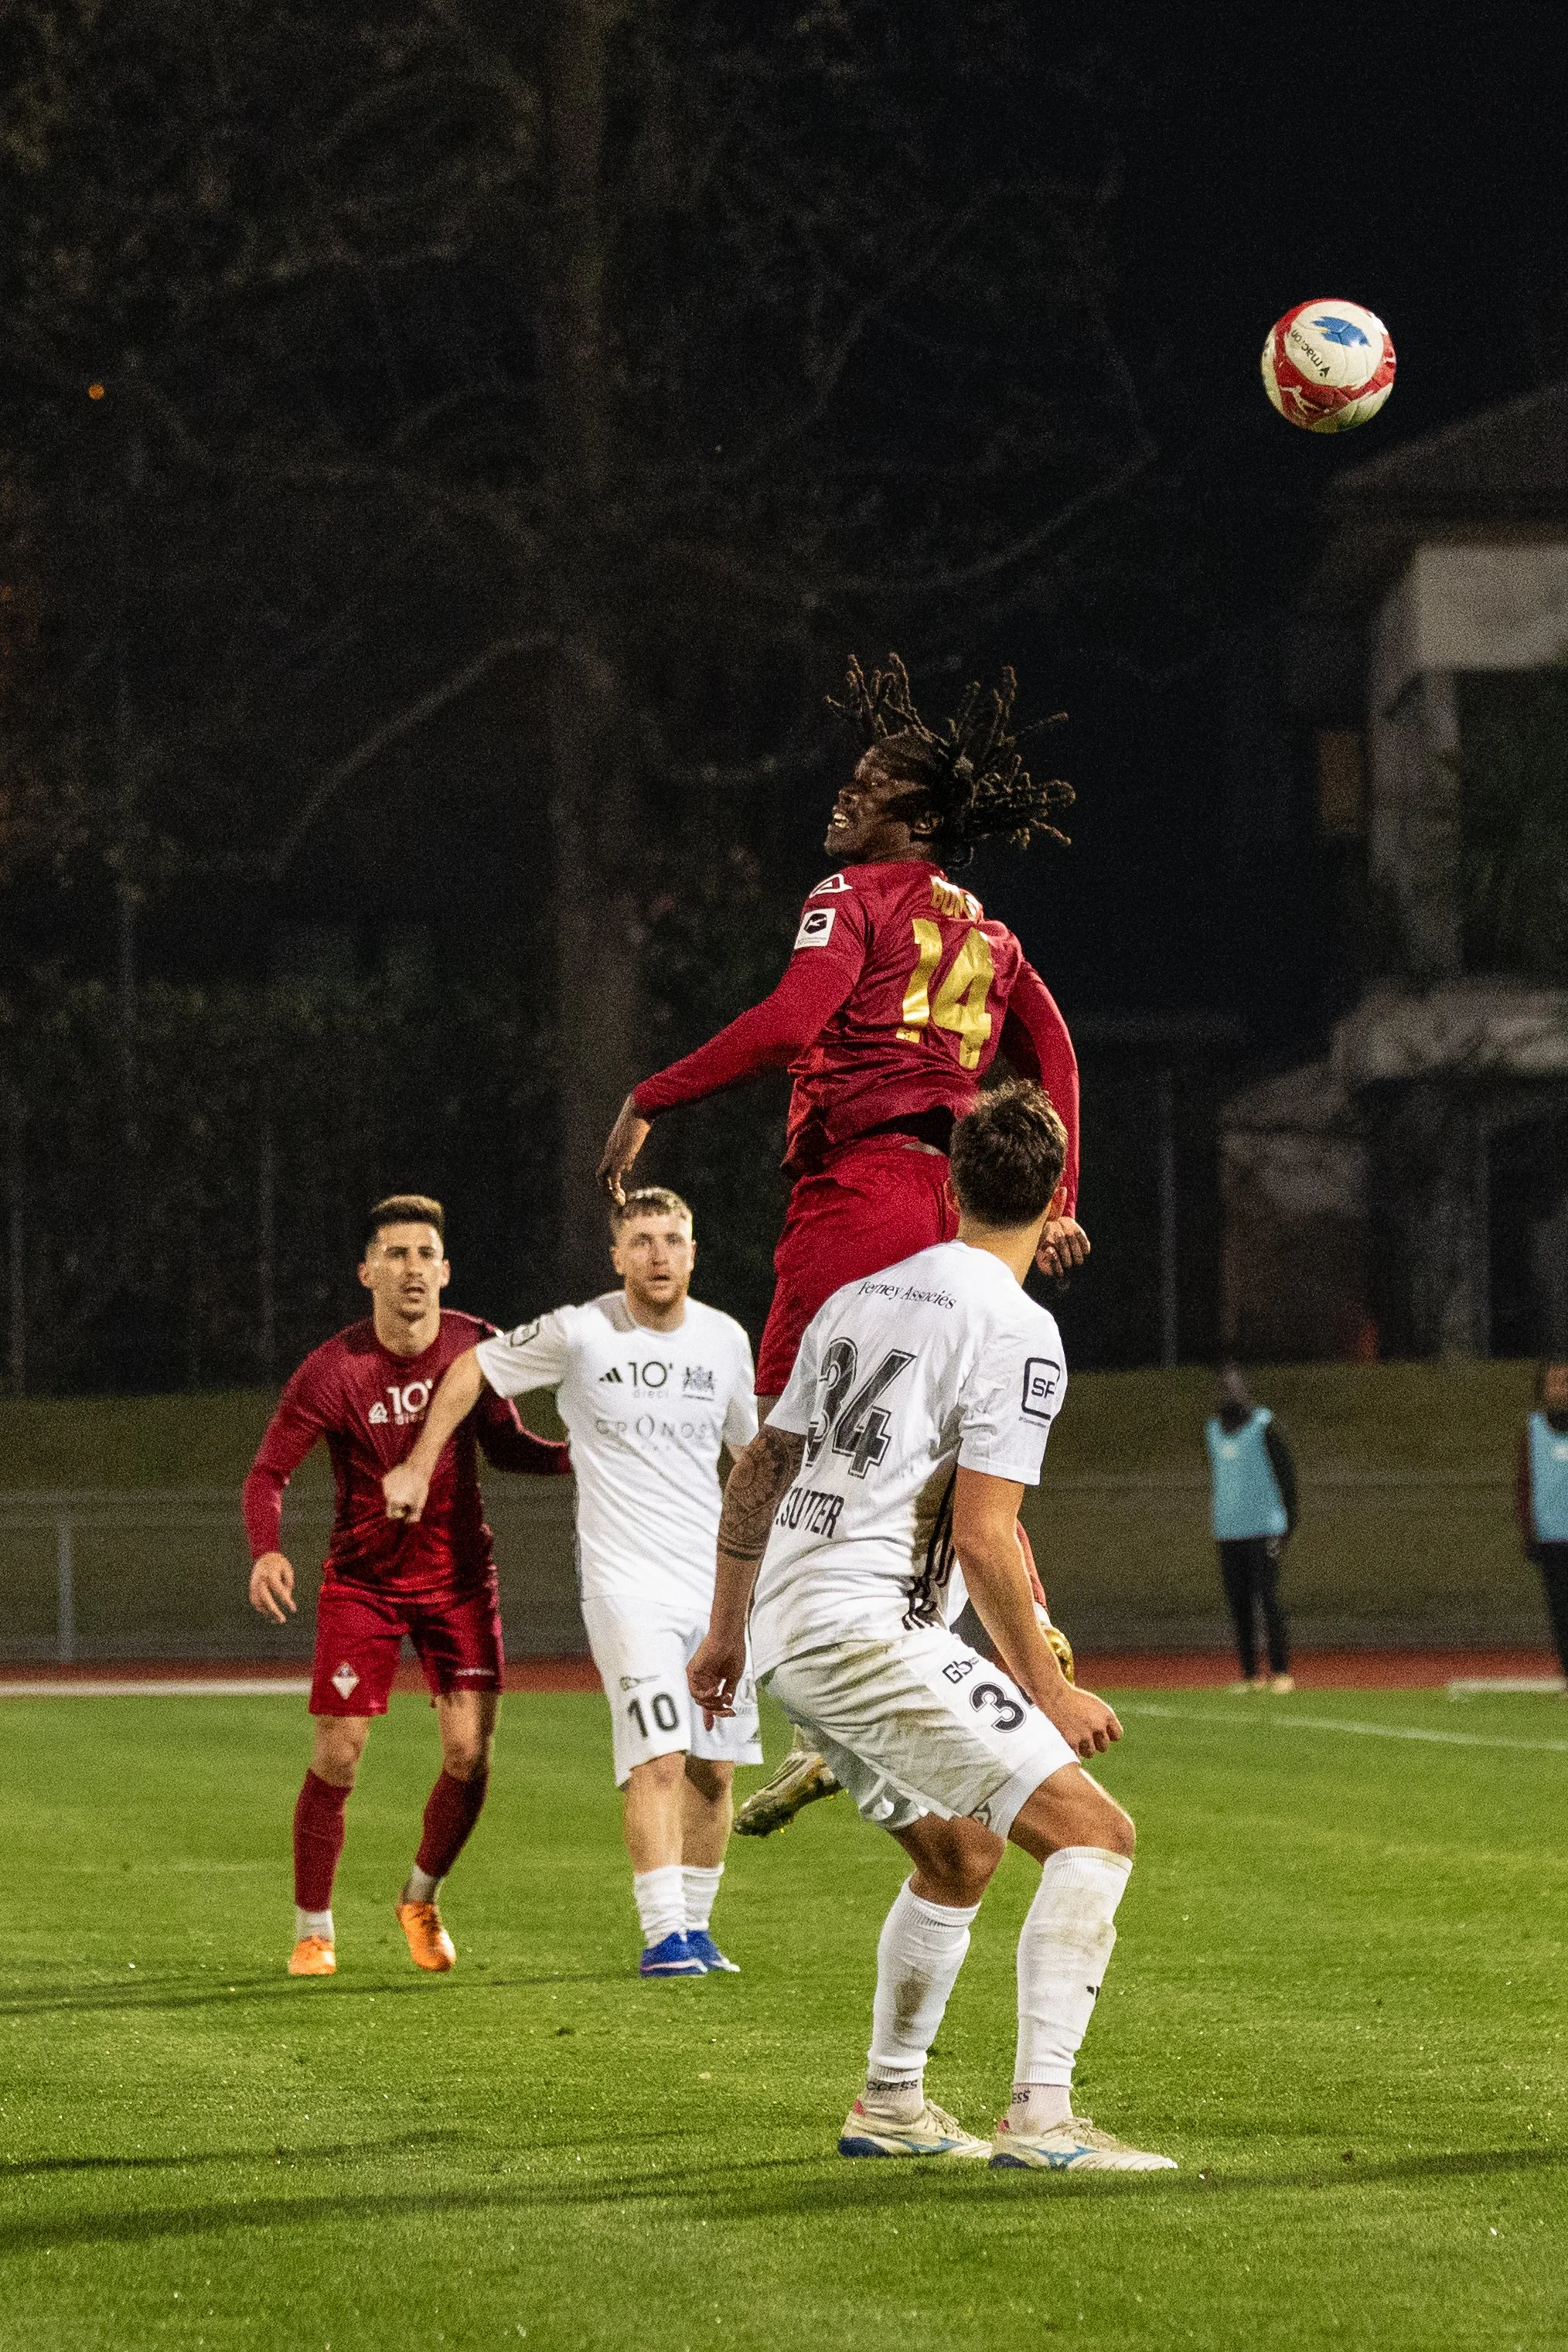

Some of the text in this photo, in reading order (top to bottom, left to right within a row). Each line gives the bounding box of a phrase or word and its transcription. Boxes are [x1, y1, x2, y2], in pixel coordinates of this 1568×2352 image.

[895, 918, 994, 1070] 14
[806, 1337, 917, 1479] 34
[1031, 1376, 1055, 1399] SF
[627, 1691, 680, 1739] 10
[970, 1682, 1036, 1733] 3
